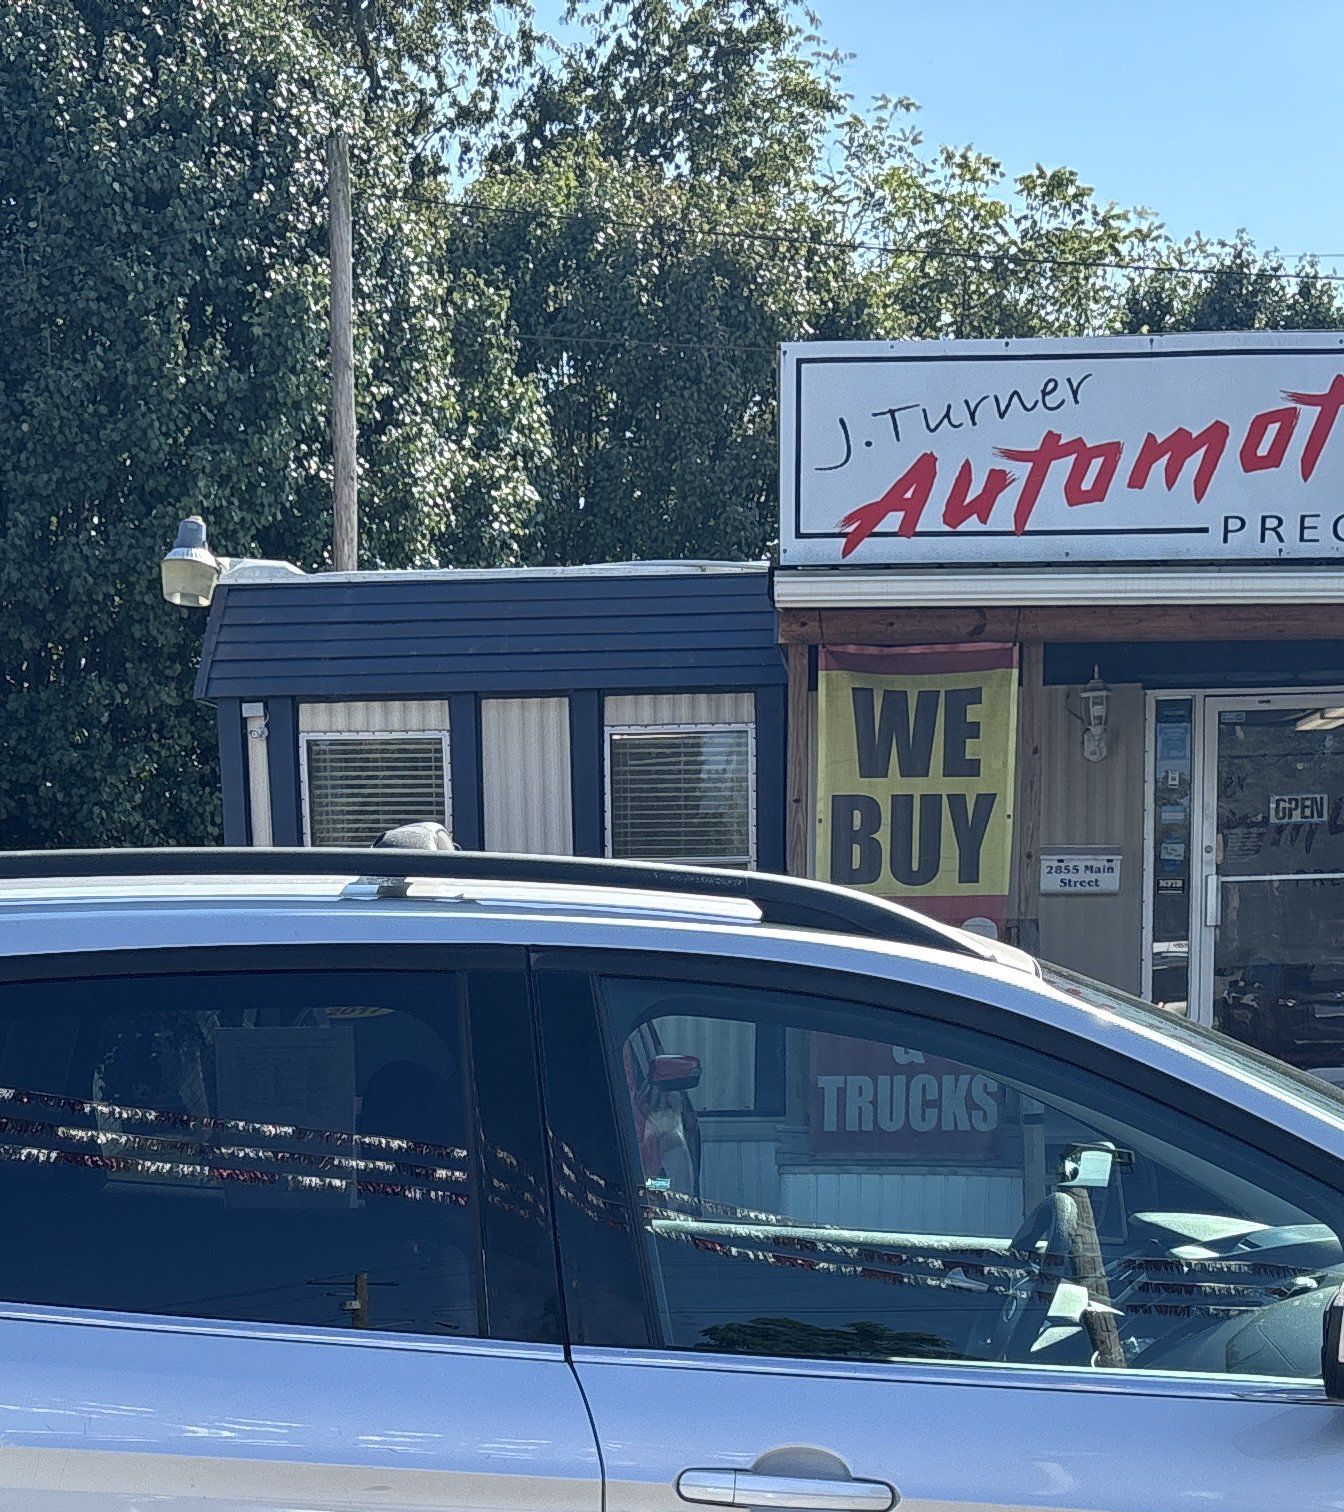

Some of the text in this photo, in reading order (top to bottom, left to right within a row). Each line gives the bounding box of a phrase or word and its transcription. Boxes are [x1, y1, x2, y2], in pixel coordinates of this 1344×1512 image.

[850, 686, 983, 779] WE
[1274, 796, 1325, 820] OPEN
[829, 792, 998, 887] BUY
[1045, 864, 1115, 875] 2855 Main
[1058, 877, 1101, 888] Street
[816, 1073, 999, 1133] TRUCKS
